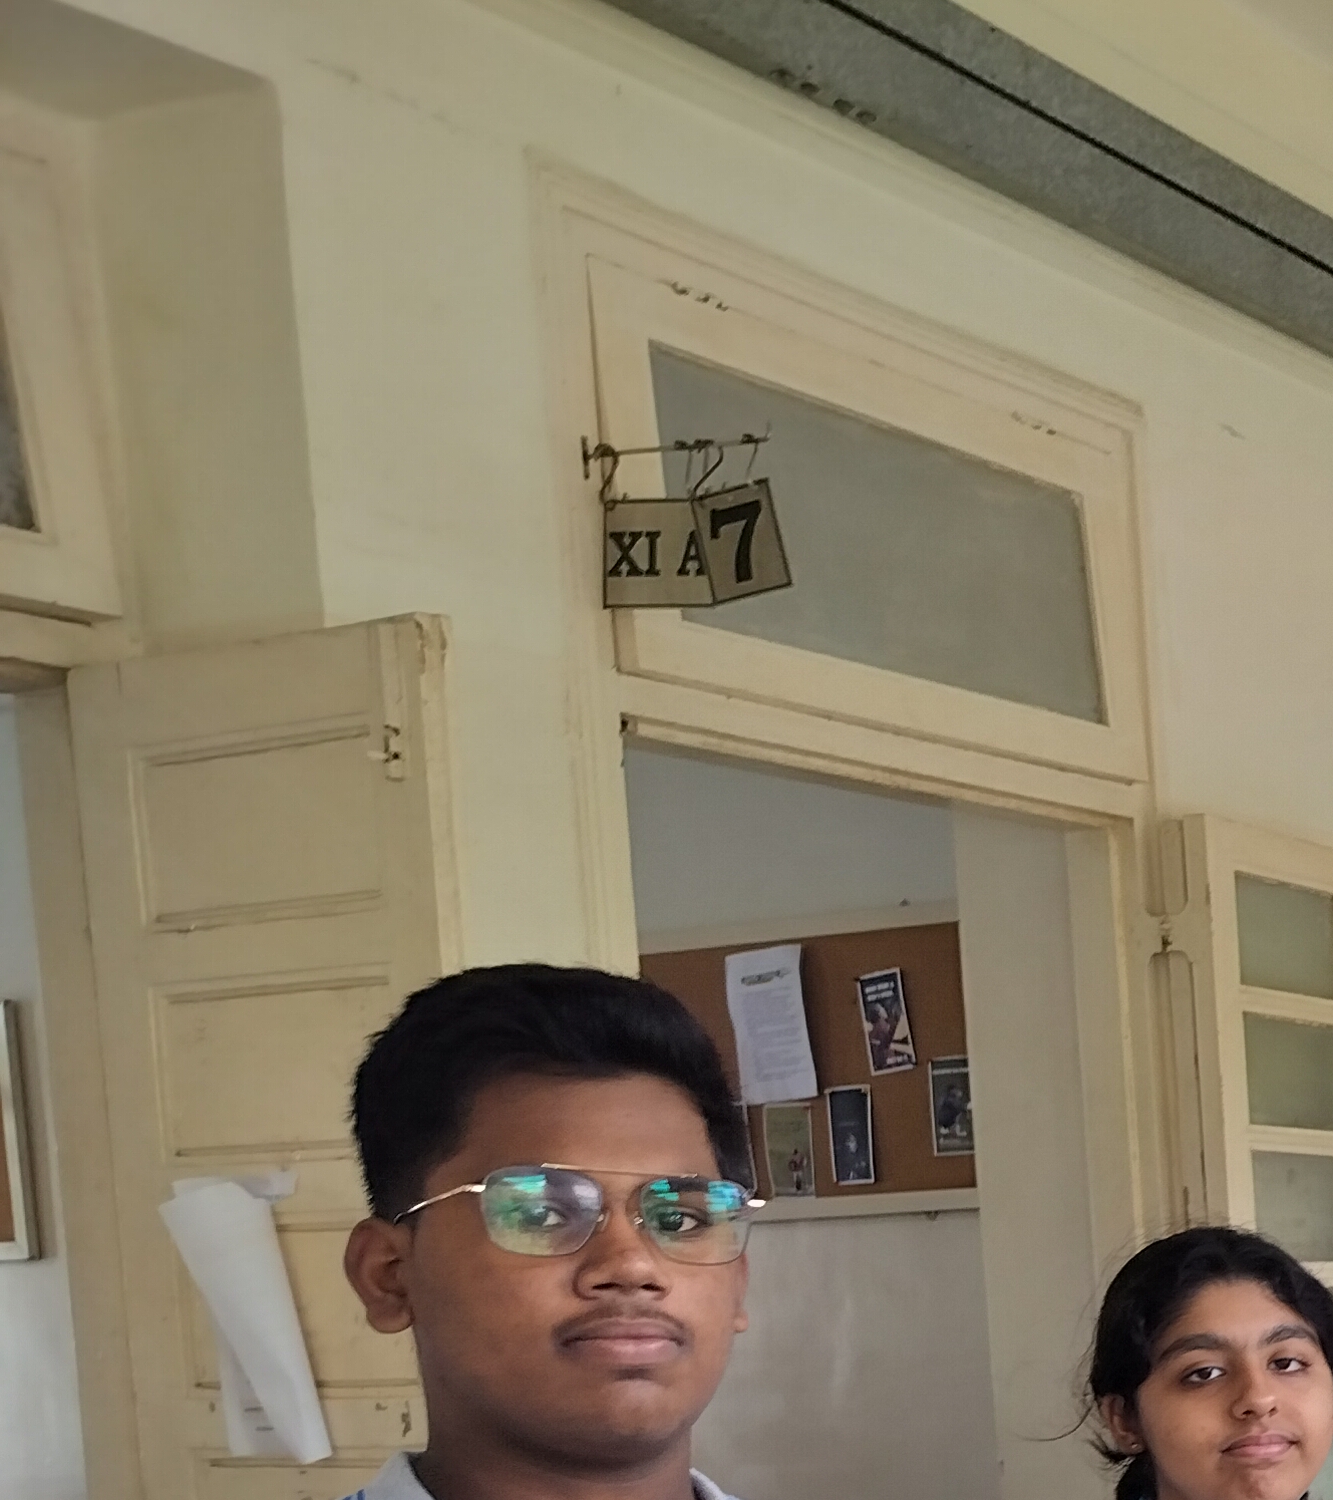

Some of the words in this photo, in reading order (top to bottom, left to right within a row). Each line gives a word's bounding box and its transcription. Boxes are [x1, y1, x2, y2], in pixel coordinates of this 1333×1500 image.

[608, 530, 662, 578] XI
[676, 529, 706, 577] A
[710, 499, 762, 585] 7
